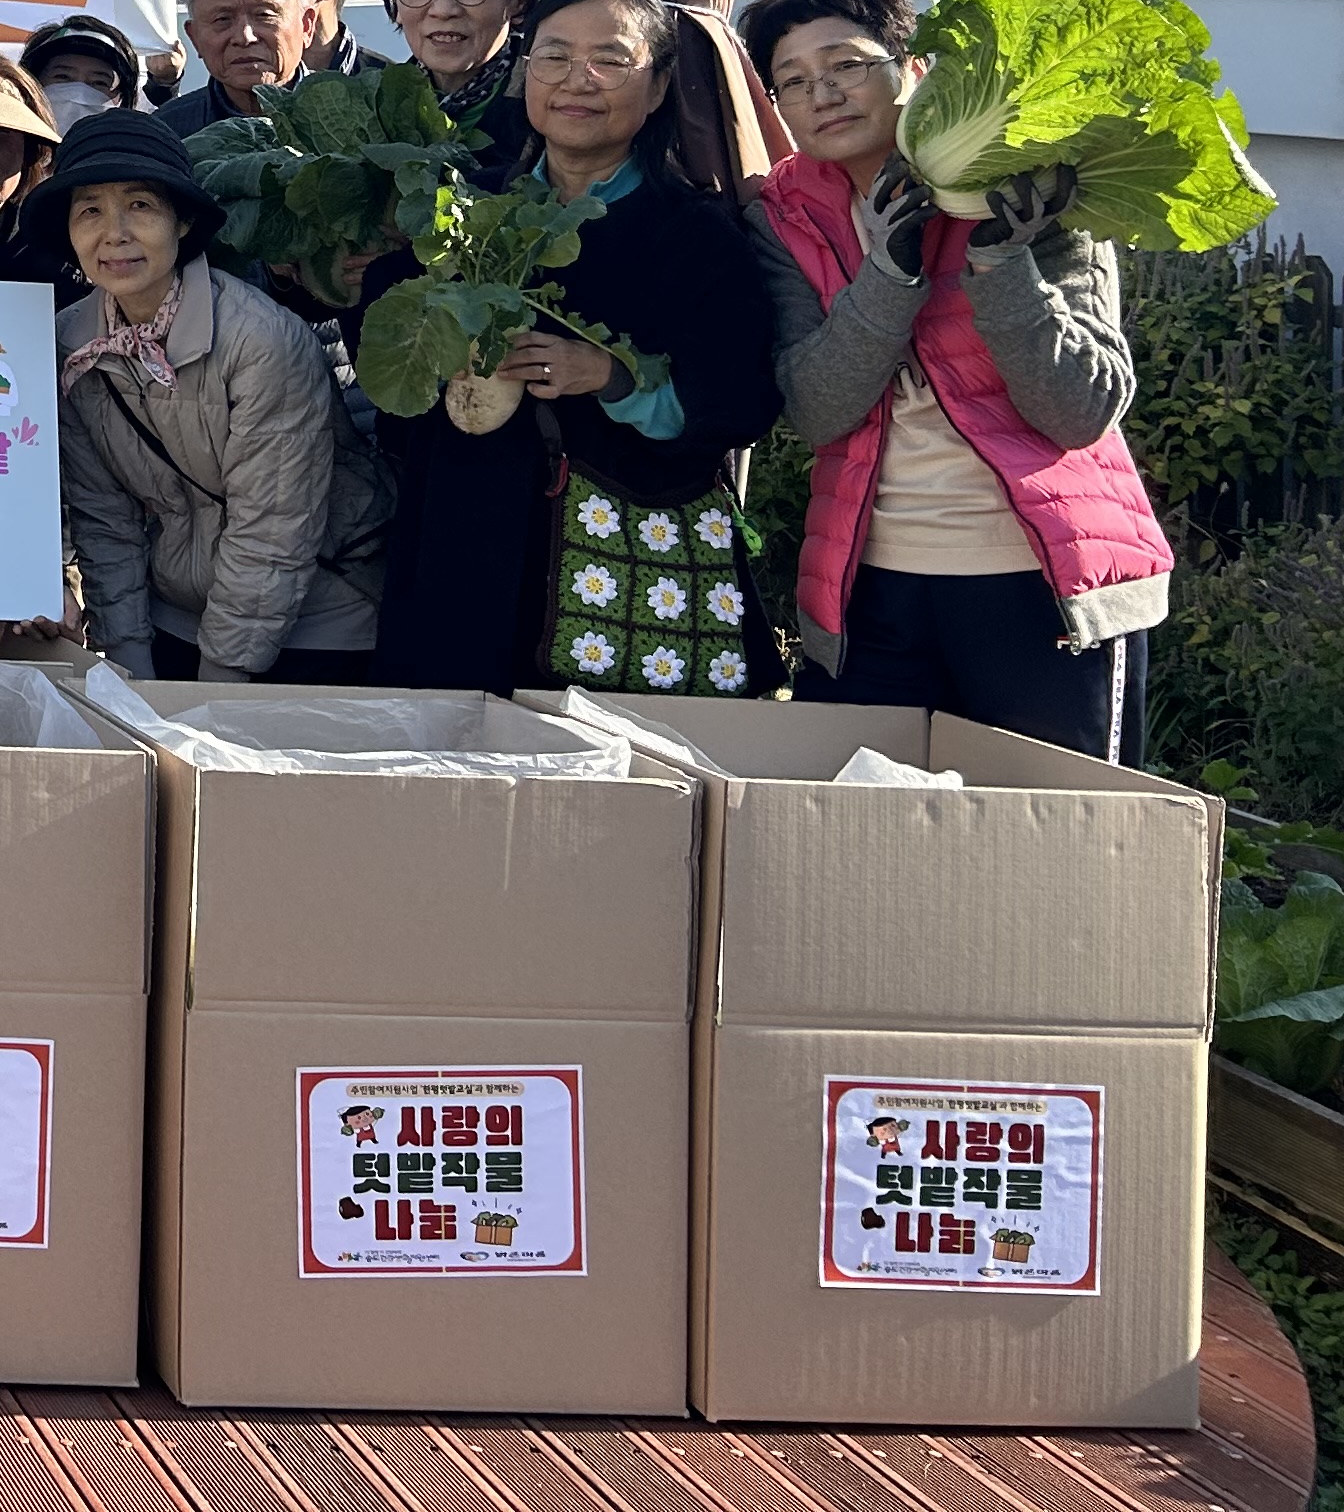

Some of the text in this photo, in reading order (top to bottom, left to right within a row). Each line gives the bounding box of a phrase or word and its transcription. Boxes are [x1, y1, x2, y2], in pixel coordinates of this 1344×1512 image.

[397, 1104, 524, 1147] 사랑의
[920, 1119, 1045, 1165] 사랑의
[352, 1151, 523, 1194] 텃밭작물
[875, 1164, 1043, 1211] 텃밭작물
